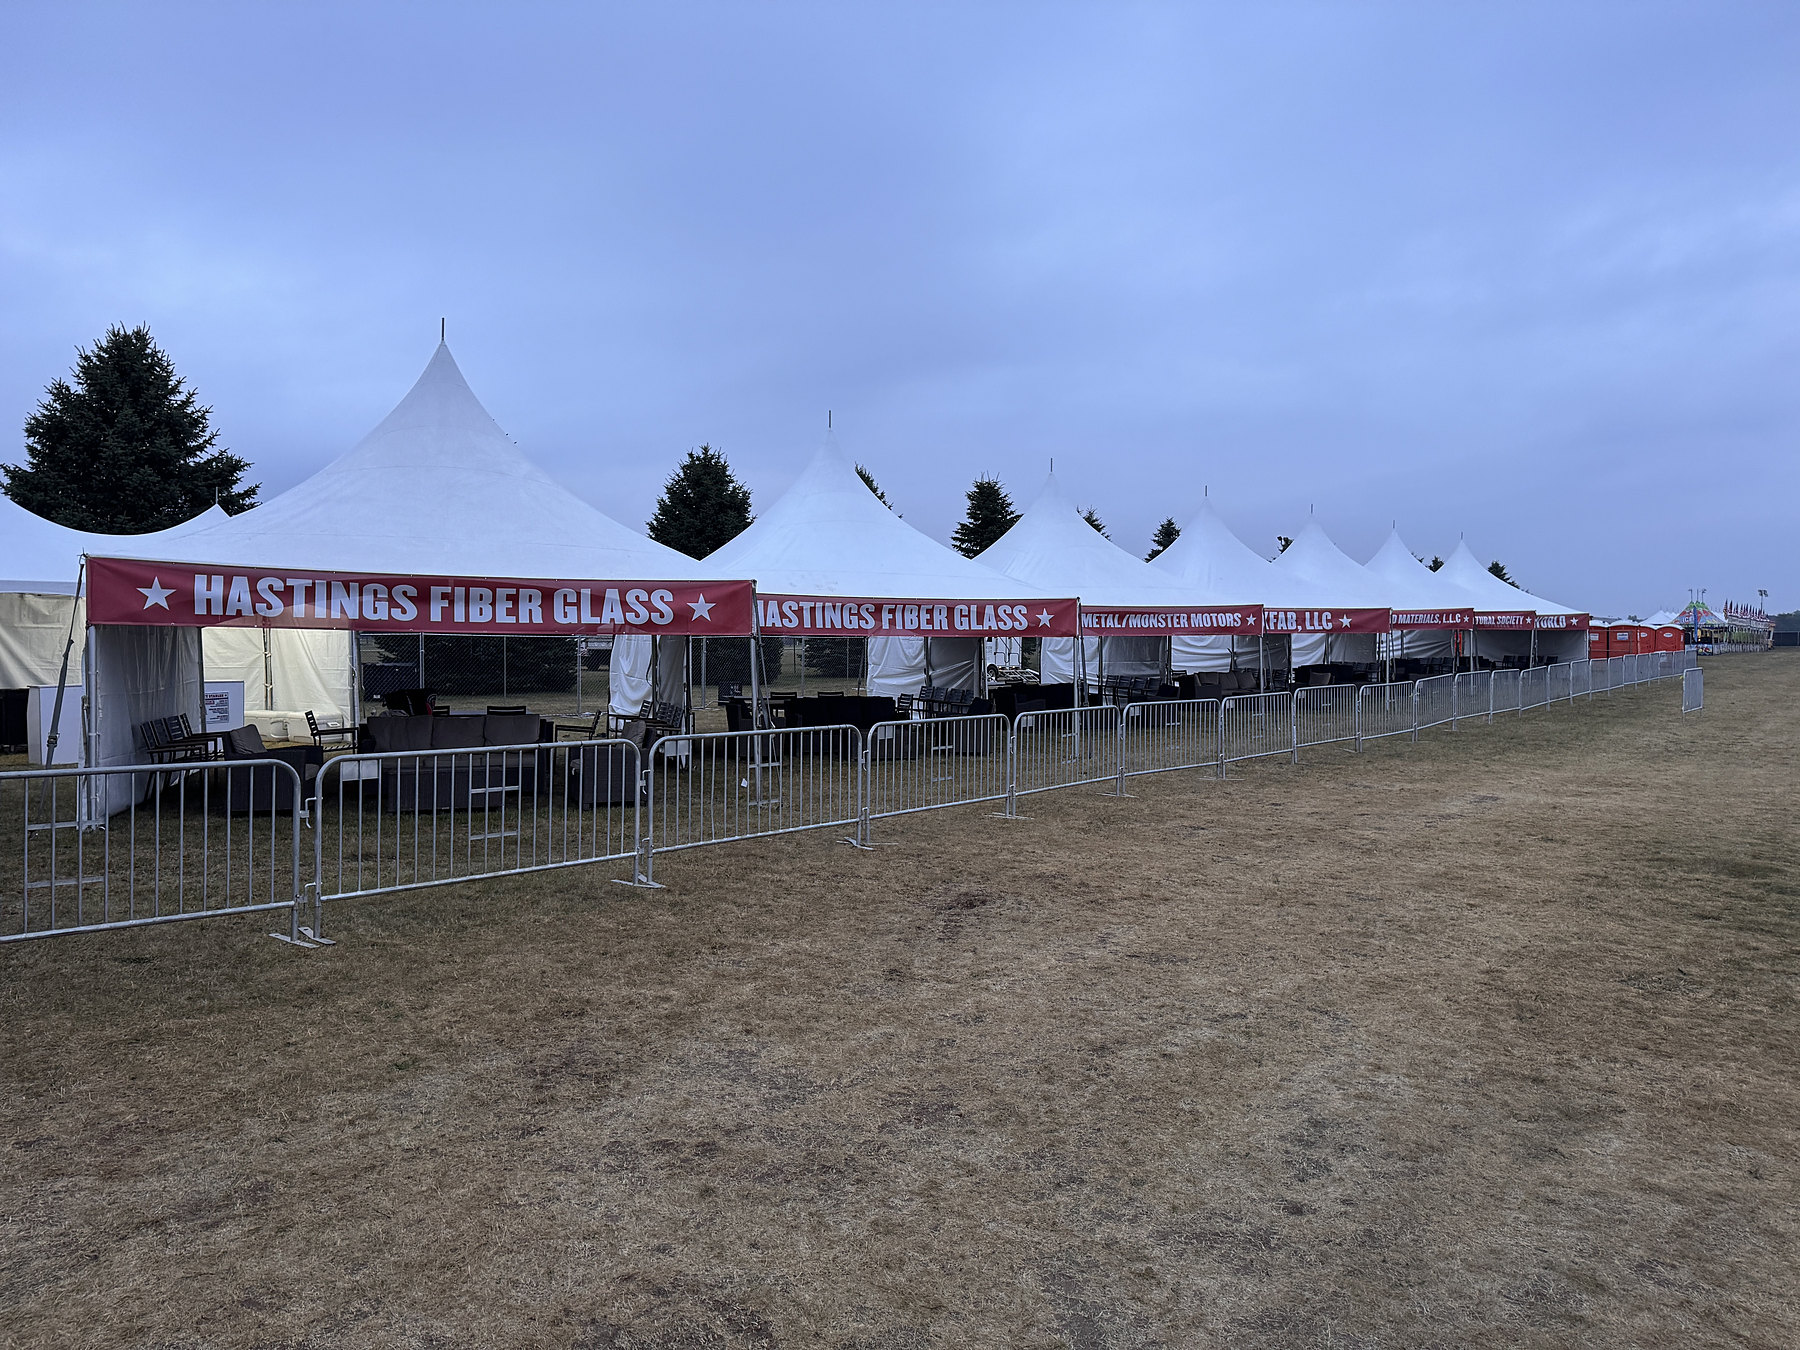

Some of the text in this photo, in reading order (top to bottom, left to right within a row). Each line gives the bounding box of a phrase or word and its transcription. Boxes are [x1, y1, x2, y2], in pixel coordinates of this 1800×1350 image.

[194, 574, 674, 626] HASTINGS FIBER GLASS
[881, 604, 949, 631] FIBER
[954, 605, 1029, 631] GLASS
[1081, 612, 1242, 628] METAL/MONSTER MOTORS
[1305, 611, 1333, 630] LLC
[1496, 615, 1525, 625] SOCIETY
